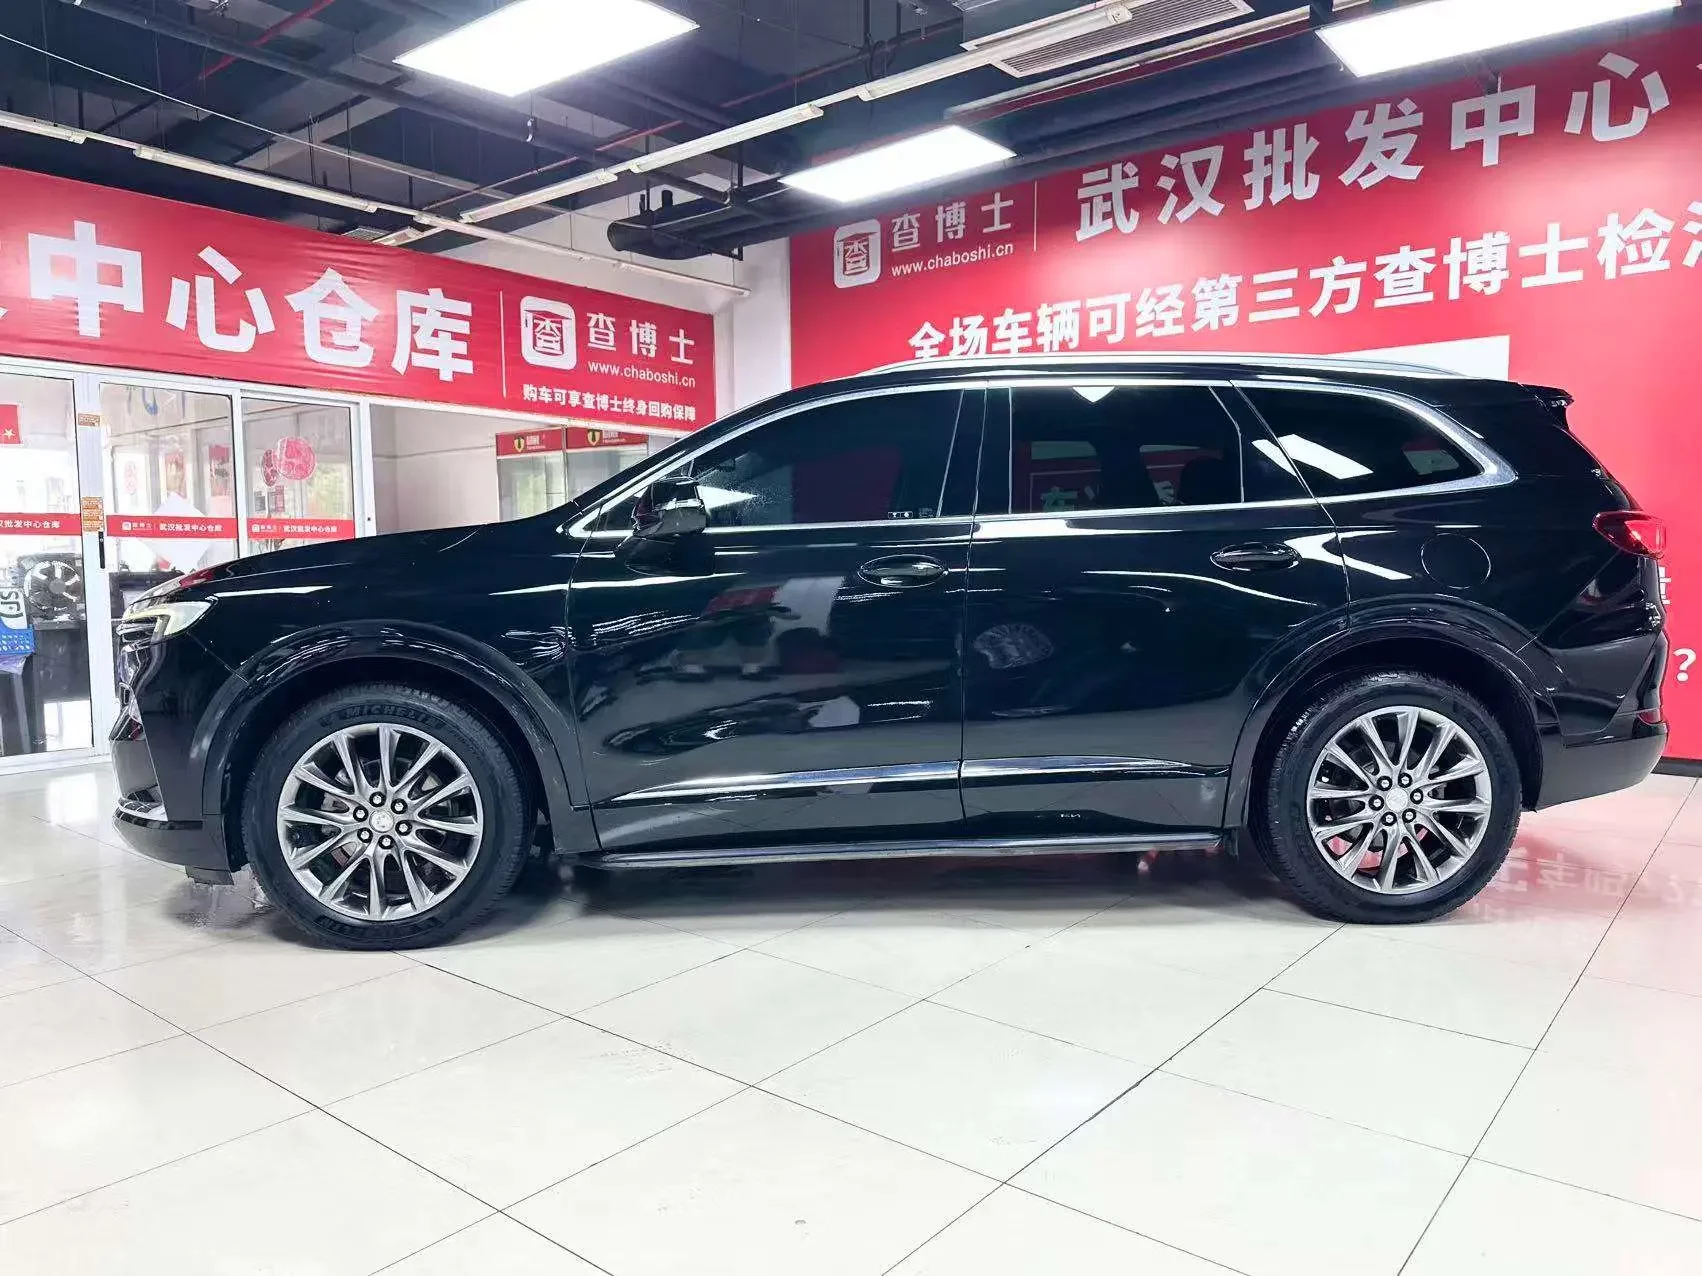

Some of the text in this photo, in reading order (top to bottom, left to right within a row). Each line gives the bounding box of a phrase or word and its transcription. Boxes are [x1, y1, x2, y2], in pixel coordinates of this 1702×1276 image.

[1075, 51, 1702, 242] 武汉批发中心
[891, 192, 1014, 253] 查博士
[891, 243, 1014, 277] www.chaboshi.cn
[0, 219, 474, 382] 中心仓库
[586, 312, 695, 365] 查博士
[588, 361, 696, 388] www.chaboshi.cn
[522, 383, 697, 422] 购车可享查博士终身回购保障
